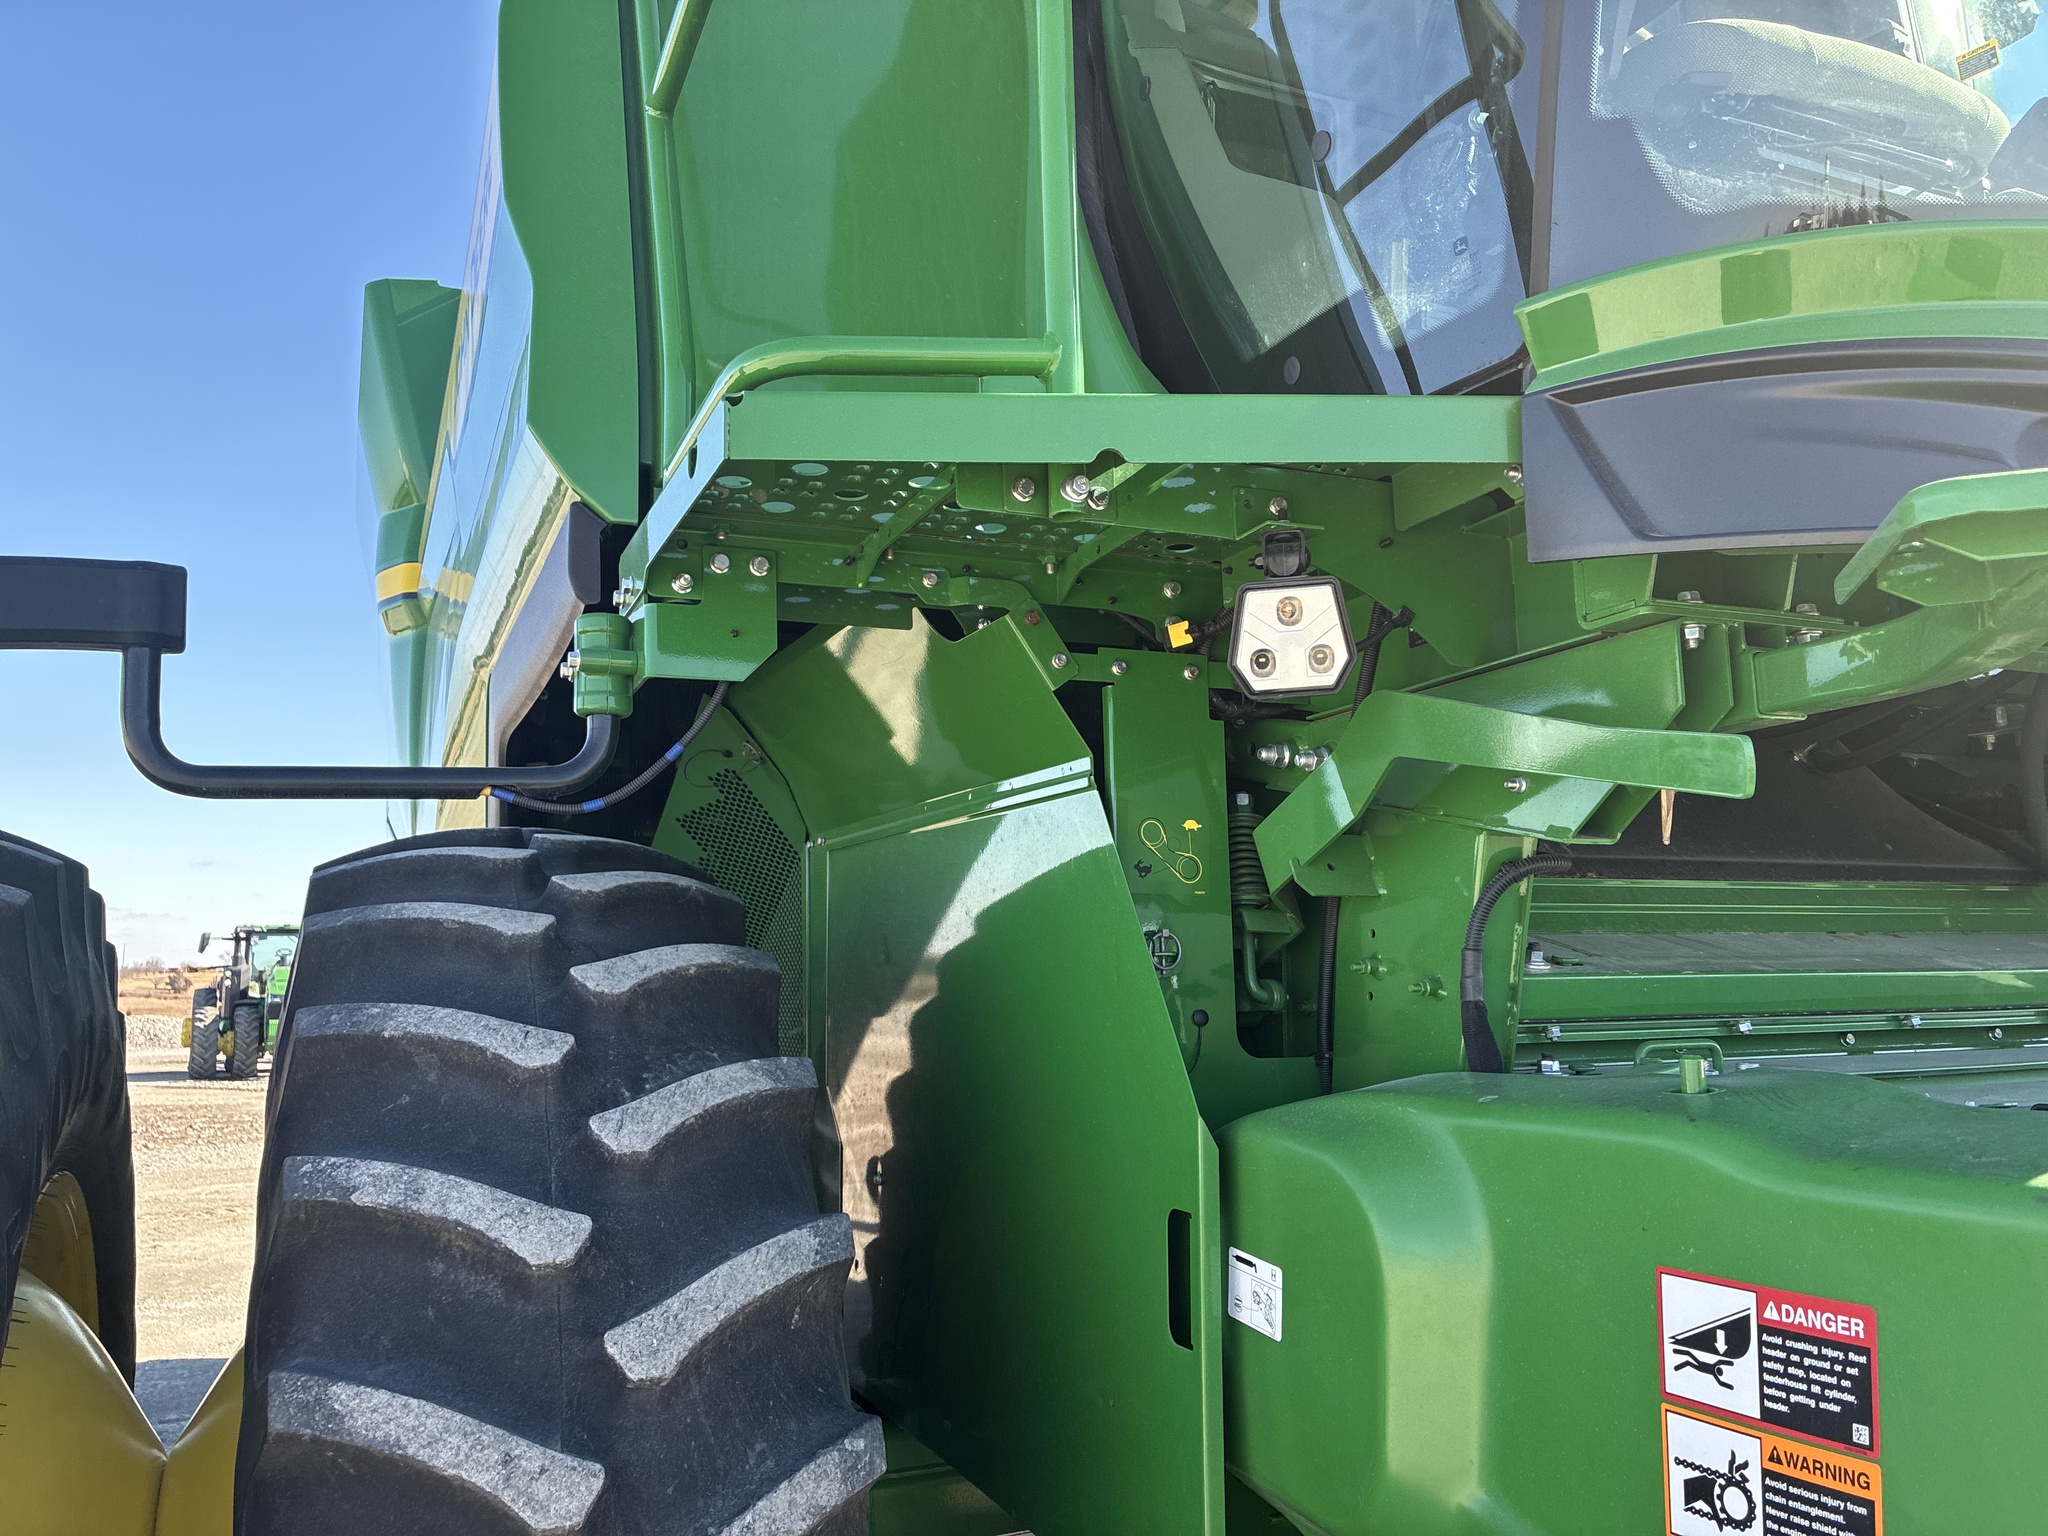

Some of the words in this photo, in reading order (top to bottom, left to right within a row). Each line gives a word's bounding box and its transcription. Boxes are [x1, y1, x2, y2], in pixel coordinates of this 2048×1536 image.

[1781, 1304, 1864, 1338] DANGER
[1762, 1333, 1782, 1345] Avoid
[1786, 1340, 1818, 1354] crushing
[1822, 1347, 1845, 1360] injury.
[1849, 1352, 1866, 1363] Rest
[1762, 1346, 1786, 1358] header
[1790, 1353, 1800, 1362] on
[1804, 1357, 1830, 1369] ground
[1846, 1367, 1858, 1376] set
[1763, 1361, 1784, 1373] safety
[1788, 1366, 1806, 1378] stop,
[1810, 1371, 1837, 1384] located
[1841, 1379, 1851, 1387] on
[1763, 1373, 1807, 1390] feederhouse
[1811, 1385, 1821, 1394] lift
[1825, 1388, 1857, 1404] cylinder,
[1764, 1386, 1786, 1399] before
[1790, 1393, 1815, 1408] getting
[1819, 1400, 1841, 1412] under
[1764, 1399, 1790, 1413] header.
[1784, 1450, 1870, 1491] WARNING
[1765, 1477, 1786, 1491] Avoid
[1789, 1485, 1818, 1500] serious
[1821, 1494, 1844, 1510] injury
[1847, 1502, 1867, 1515] from
[1765, 1492, 1786, 1505] chain
[1788, 1500, 1846, 1524] entanglement.
[1766, 1505, 1788, 1519] Never
[1790, 1514, 1809, 1527] raise
[1812, 1522, 1836, 1535] shield
[1766, 1520, 1778, 1531] the
